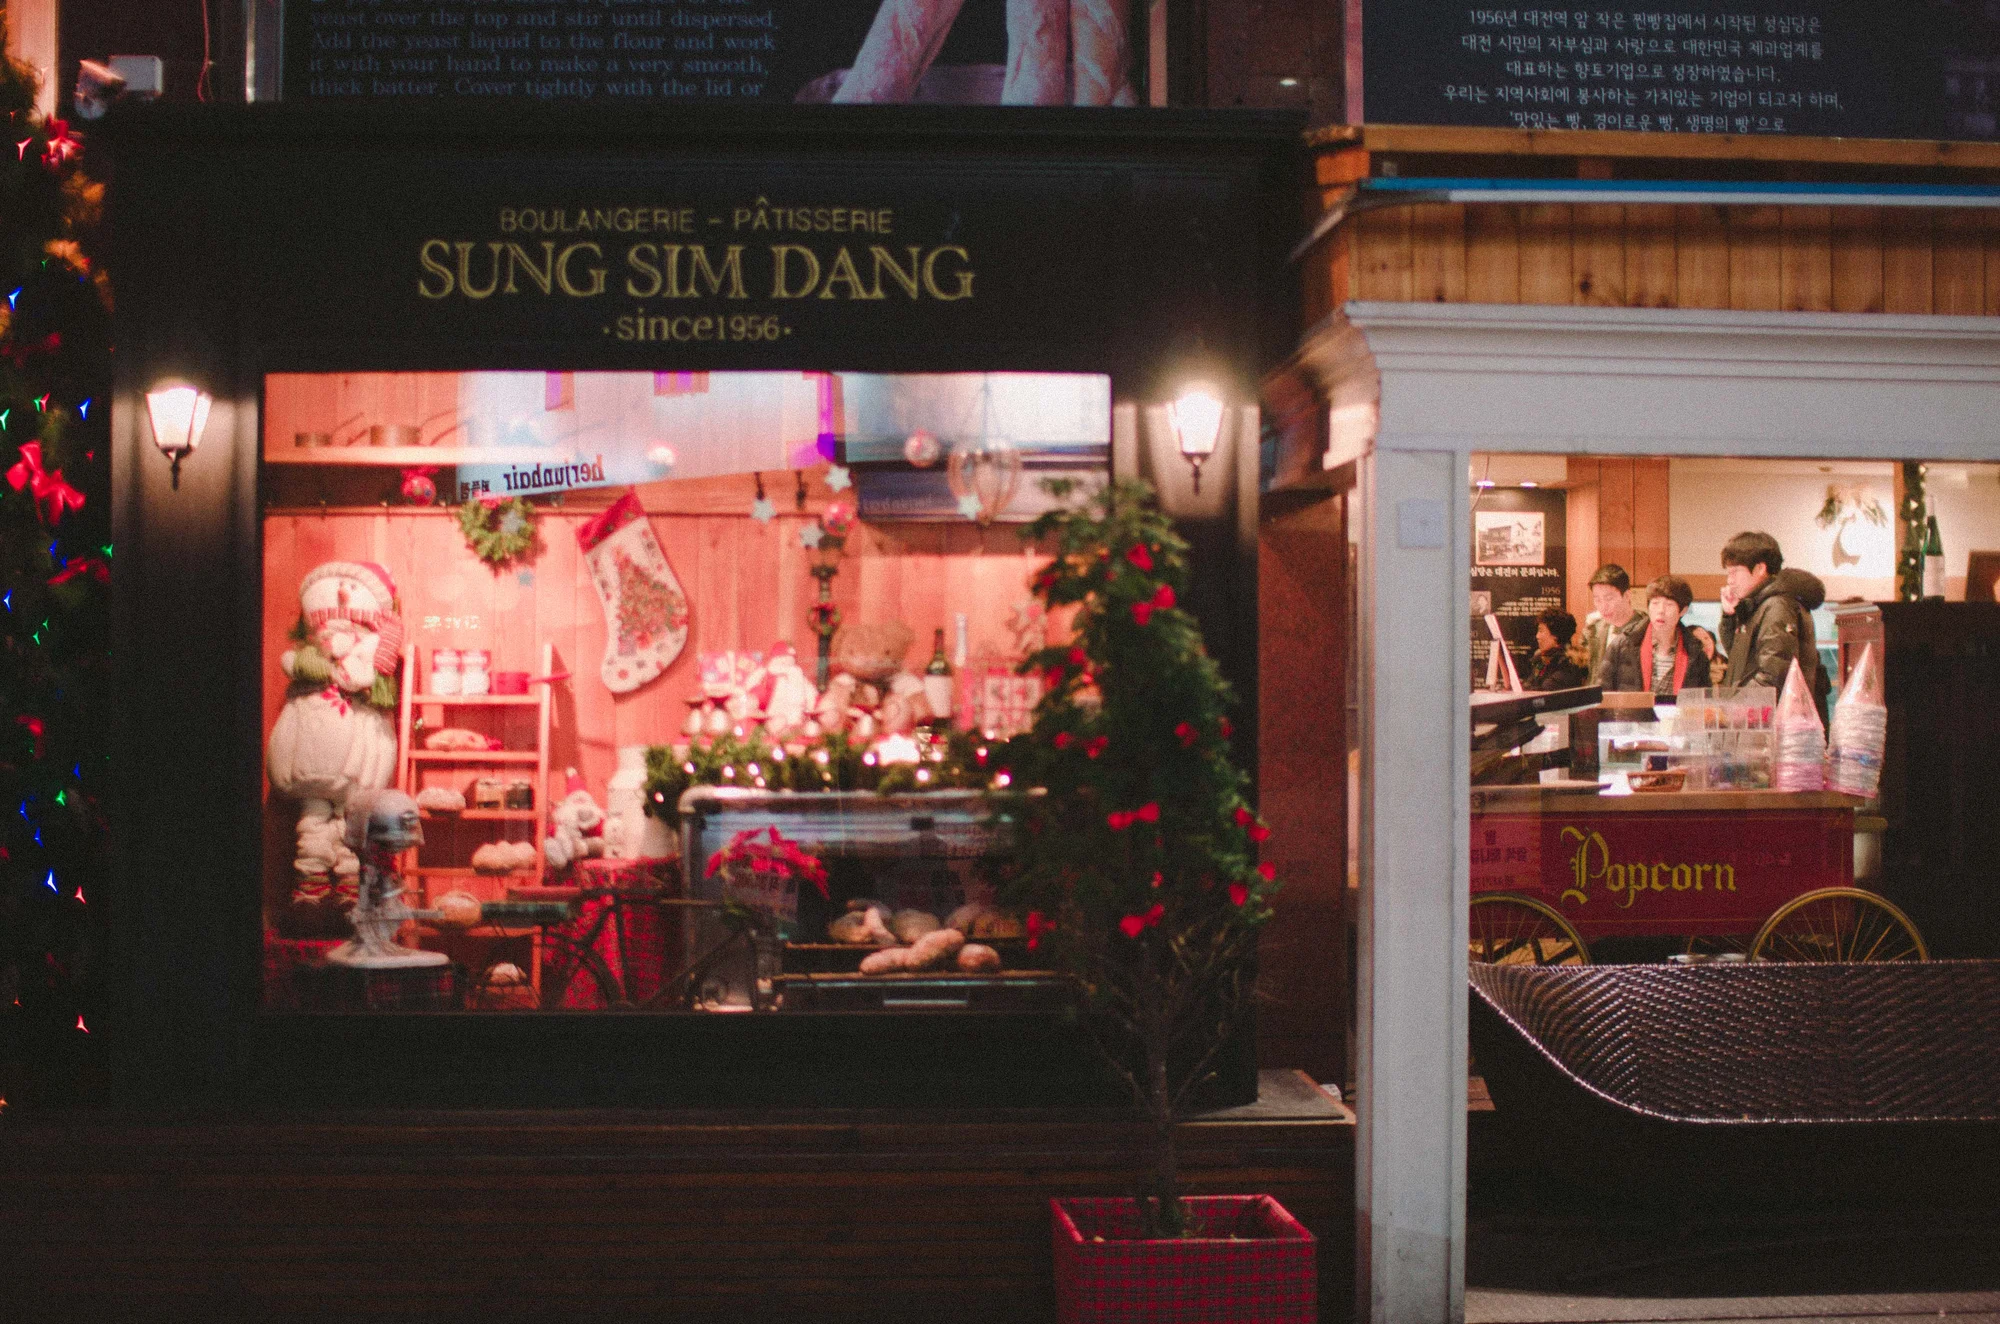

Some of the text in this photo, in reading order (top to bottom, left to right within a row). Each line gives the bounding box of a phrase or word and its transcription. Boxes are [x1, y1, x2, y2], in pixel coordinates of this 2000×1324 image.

[311, 10, 367, 30] yeast
[374, 14, 424, 26] over
[429, 10, 464, 26] the
[474, 10, 508, 30] top
[517, 10, 556, 26] and
[565, 10, 603, 26] stir
[611, 10, 663, 26] until
[1470, 10, 1822, 34] 1956년 대전역 앞 작은 찐빵집에서 시작된 성심당은
[311, 33, 776, 54] Add the yeast liquid to the flour and work
[1462, 35, 1823, 60] 대전 시민의 자부심과 사랑으로 대한민국 제과업계를
[309, 56, 322, 72] it
[334, 56, 380, 72] with
[389, 60, 437, 76] your
[446, 56, 501, 72] hand
[510, 56, 530, 72] to
[540, 56, 598, 72] make
[606, 60, 619, 72] a
[628, 60, 673, 76] very
[1507, 61, 1568, 80] 대표하는
[1574, 63, 1665, 82] 향토기업으로
[309, 78, 362, 95] thick
[454, 78, 514, 95] Cover
[525, 78, 594, 98] tightly
[605, 78, 654, 95] with
[661, 78, 696, 95] the
[704, 78, 732, 95] lid
[740, 82, 763, 95] or
[1443, 84, 1488, 103] 우리는
[1496, 85, 1569, 103] 지역사회에
[1577, 86, 1637, 105] 봉사하는
[1645, 88, 1704, 106] 가치있는
[1710, 89, 1752, 107] 기업이
[1759, 90, 1802, 108] 되고자
[501, 209, 694, 233] BOULANGERIE
[734, 197, 894, 233] PÂTISSERIE
[418, 240, 975, 300] SUNG SIM DANG
[1541, 586, 1561, 595] 1956
[1560, 825, 1737, 909] Popcorn
